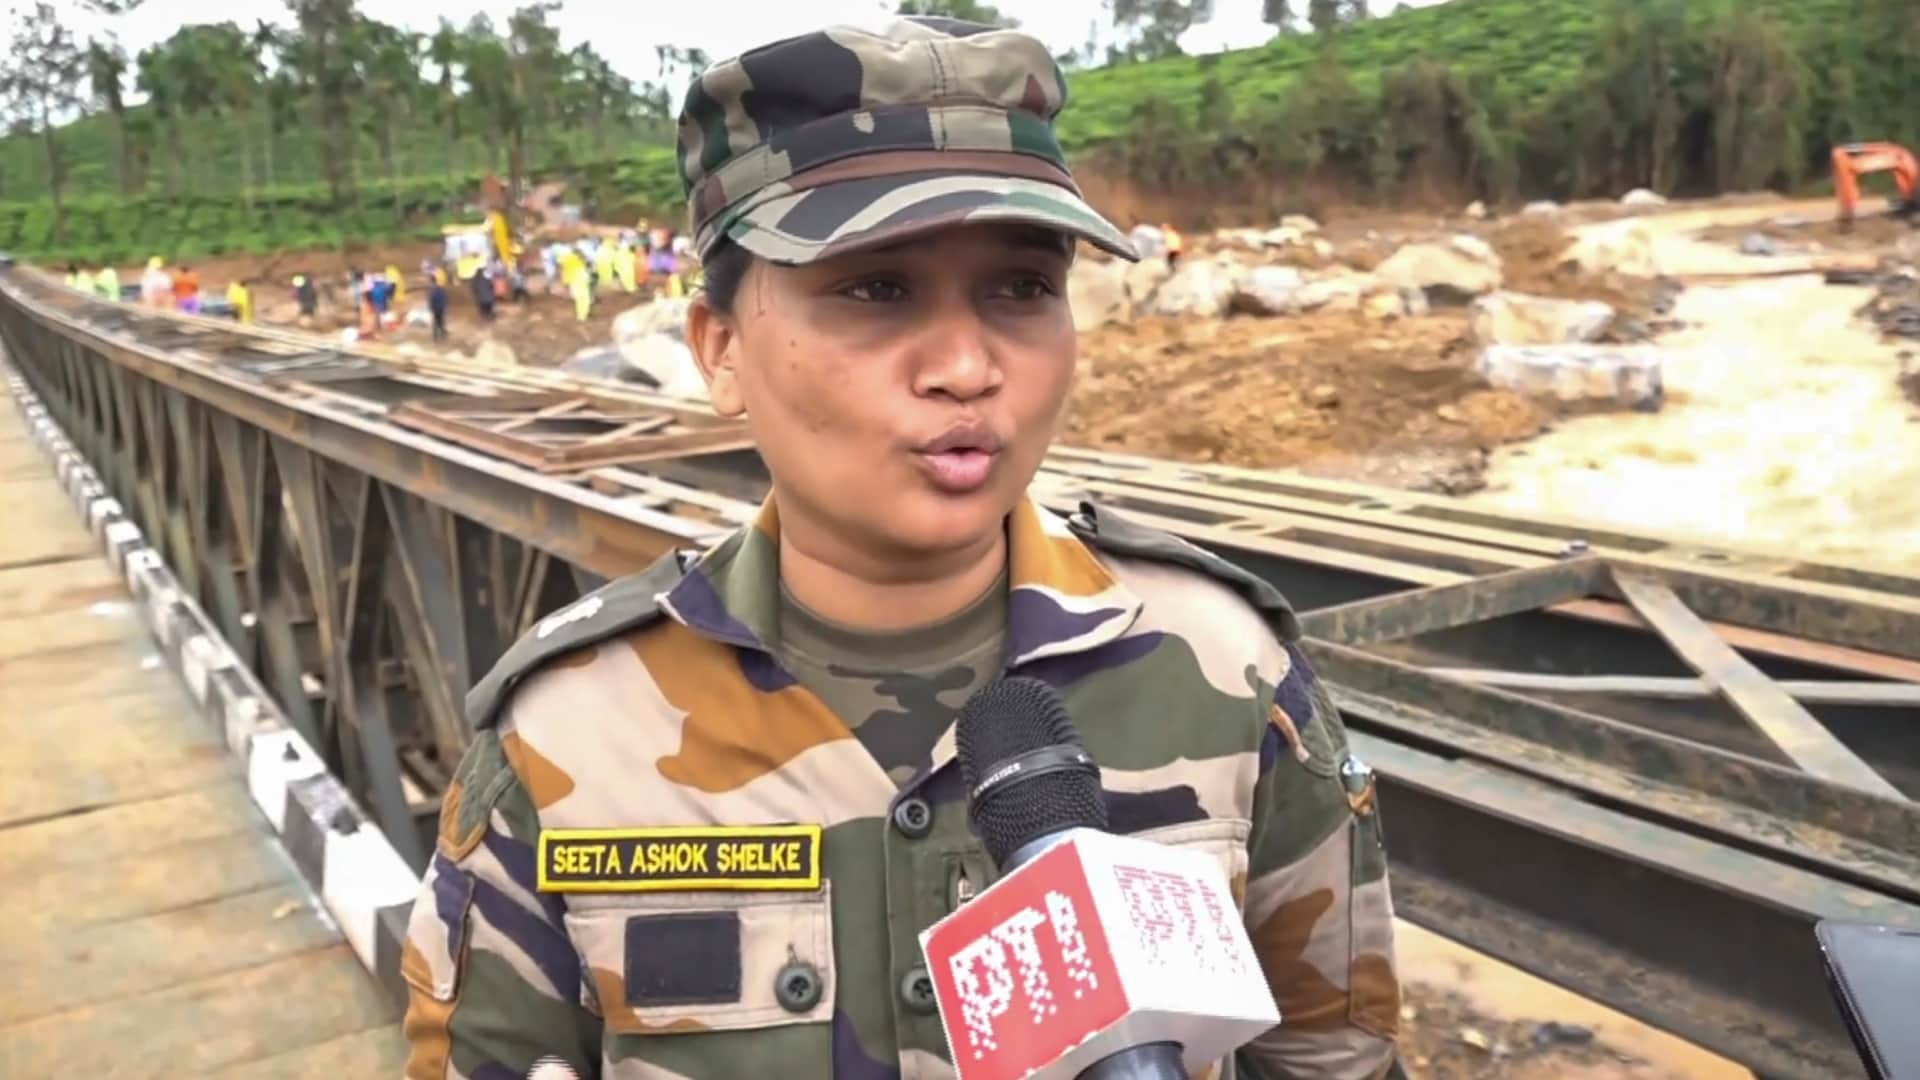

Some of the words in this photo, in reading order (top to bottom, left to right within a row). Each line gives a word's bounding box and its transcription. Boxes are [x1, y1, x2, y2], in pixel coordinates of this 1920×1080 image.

[553, 845, 622, 874] SEETA
[630, 843, 708, 874] ASHOK
[716, 842, 801, 873] SHELKE
[949, 889, 1099, 1059] PTI
